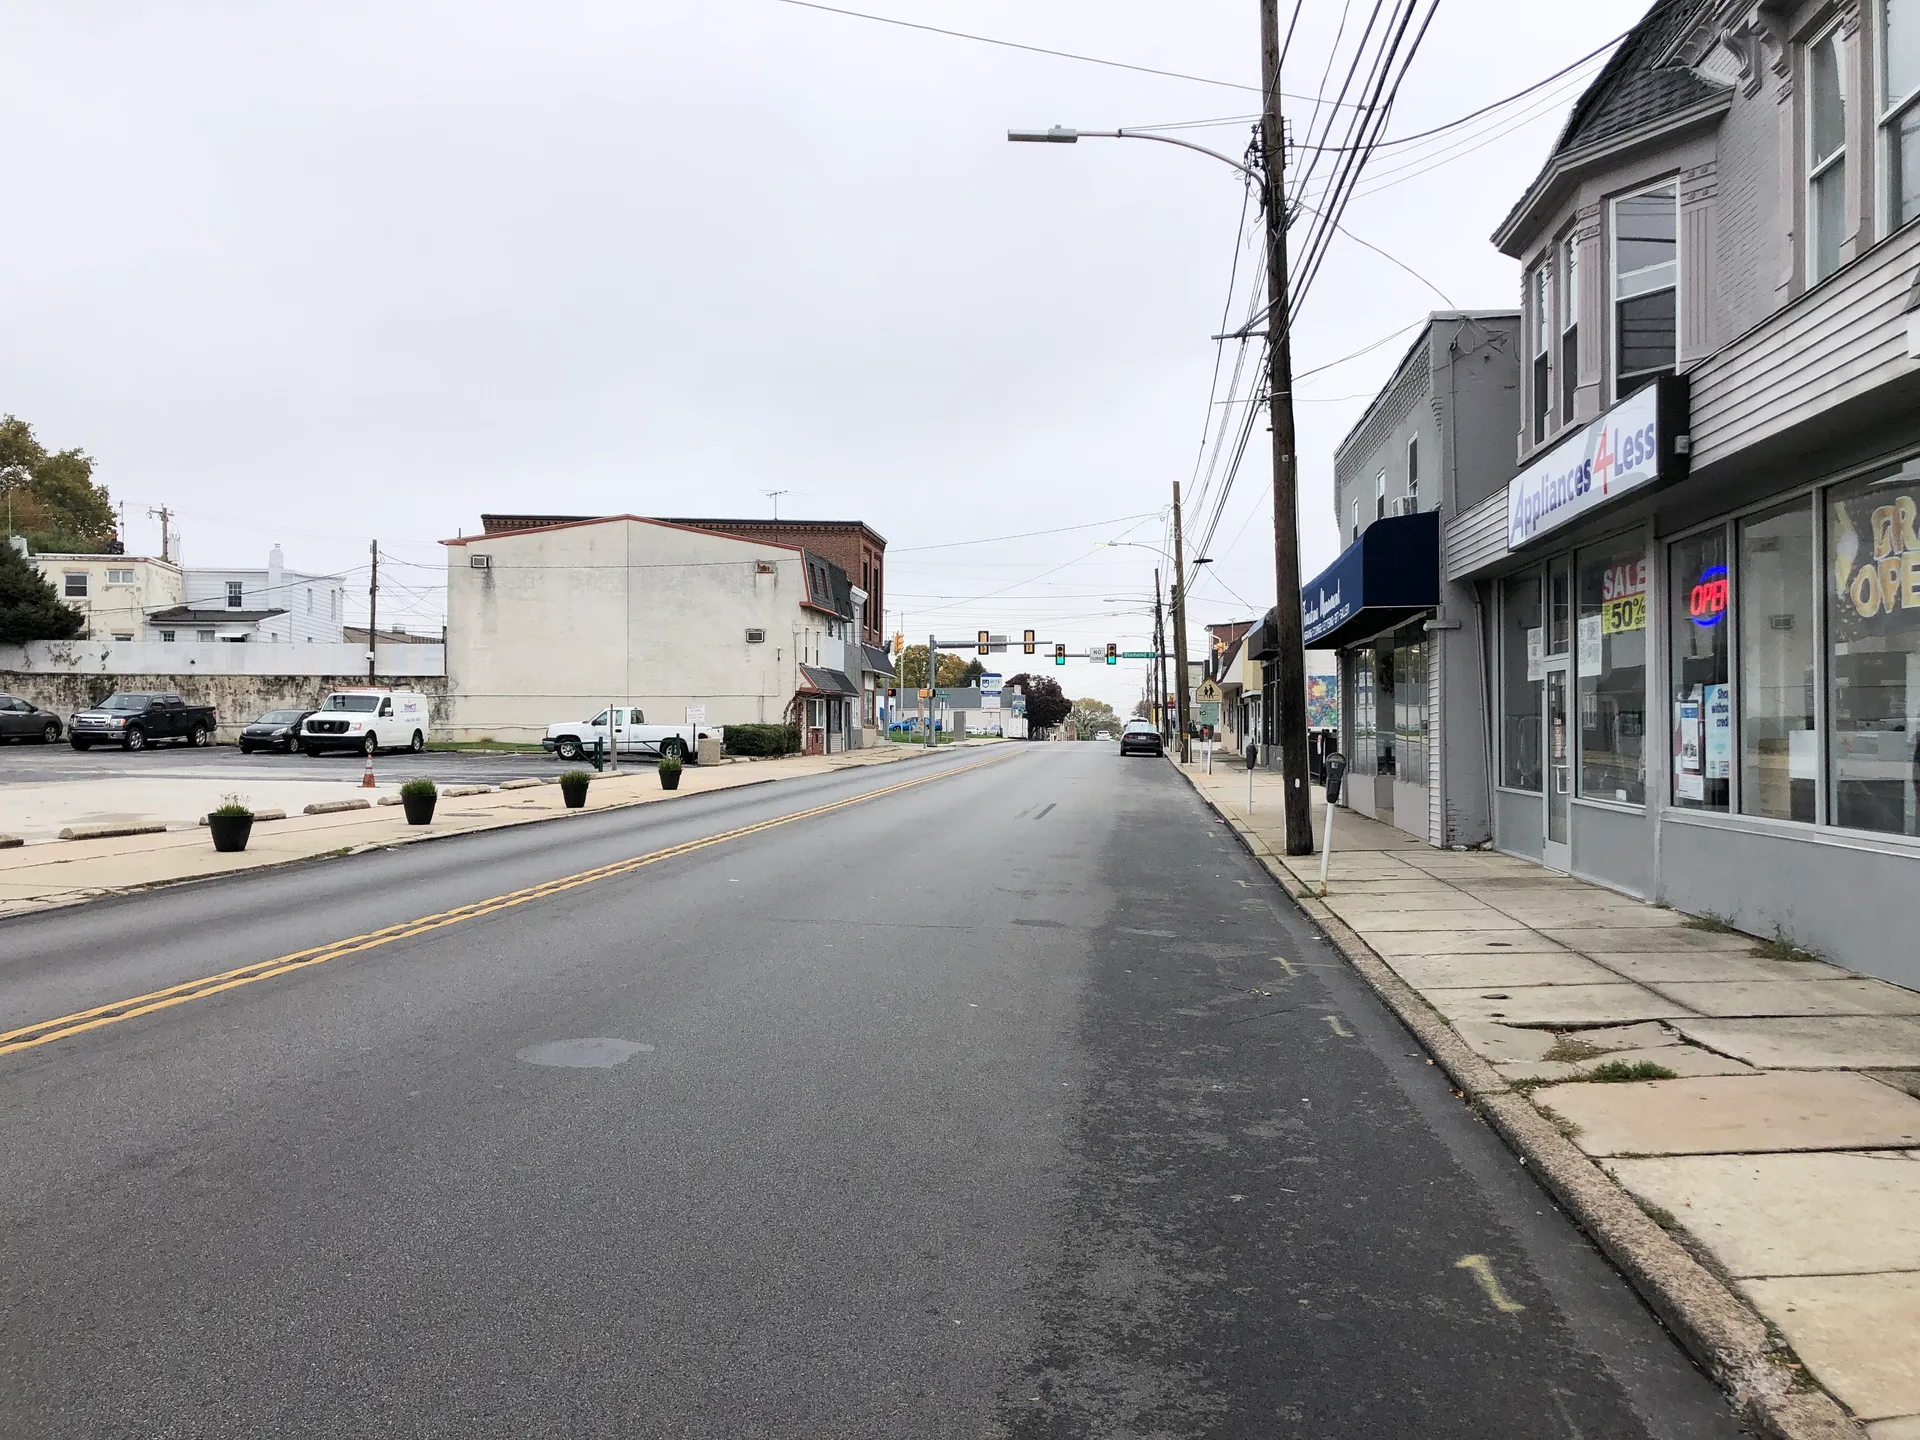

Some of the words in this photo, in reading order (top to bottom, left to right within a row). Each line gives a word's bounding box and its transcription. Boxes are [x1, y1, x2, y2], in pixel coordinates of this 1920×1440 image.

[1510, 458, 1592, 544] Appliances
[1593, 422, 1614, 496] 4
[1613, 423, 1655, 476] Less
[1603, 560, 1646, 600] SALE
[1611, 598, 1646, 629] 50%
